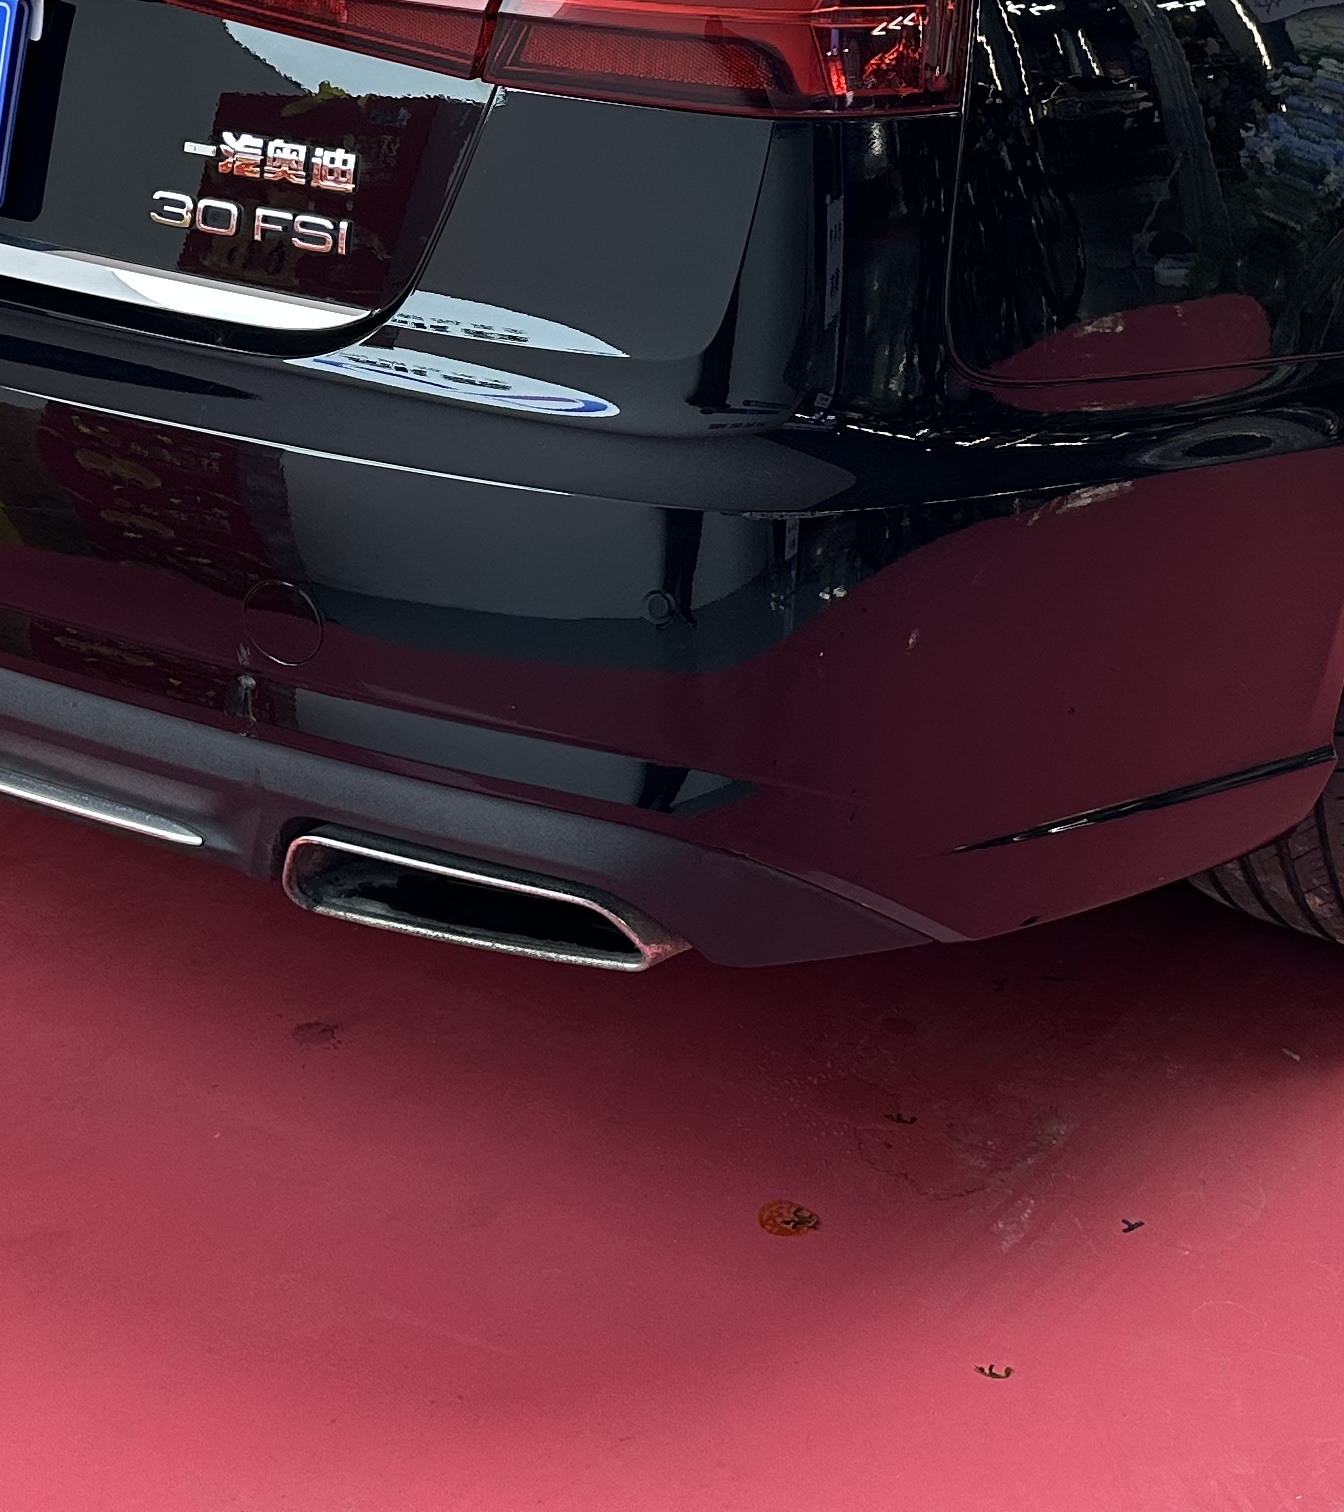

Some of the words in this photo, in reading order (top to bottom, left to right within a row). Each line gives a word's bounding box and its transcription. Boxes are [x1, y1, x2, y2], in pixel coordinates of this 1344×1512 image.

[183, 130, 358, 193] 一汽奥迪
[149, 190, 240, 238] 30
[253, 206, 354, 255] FSI
